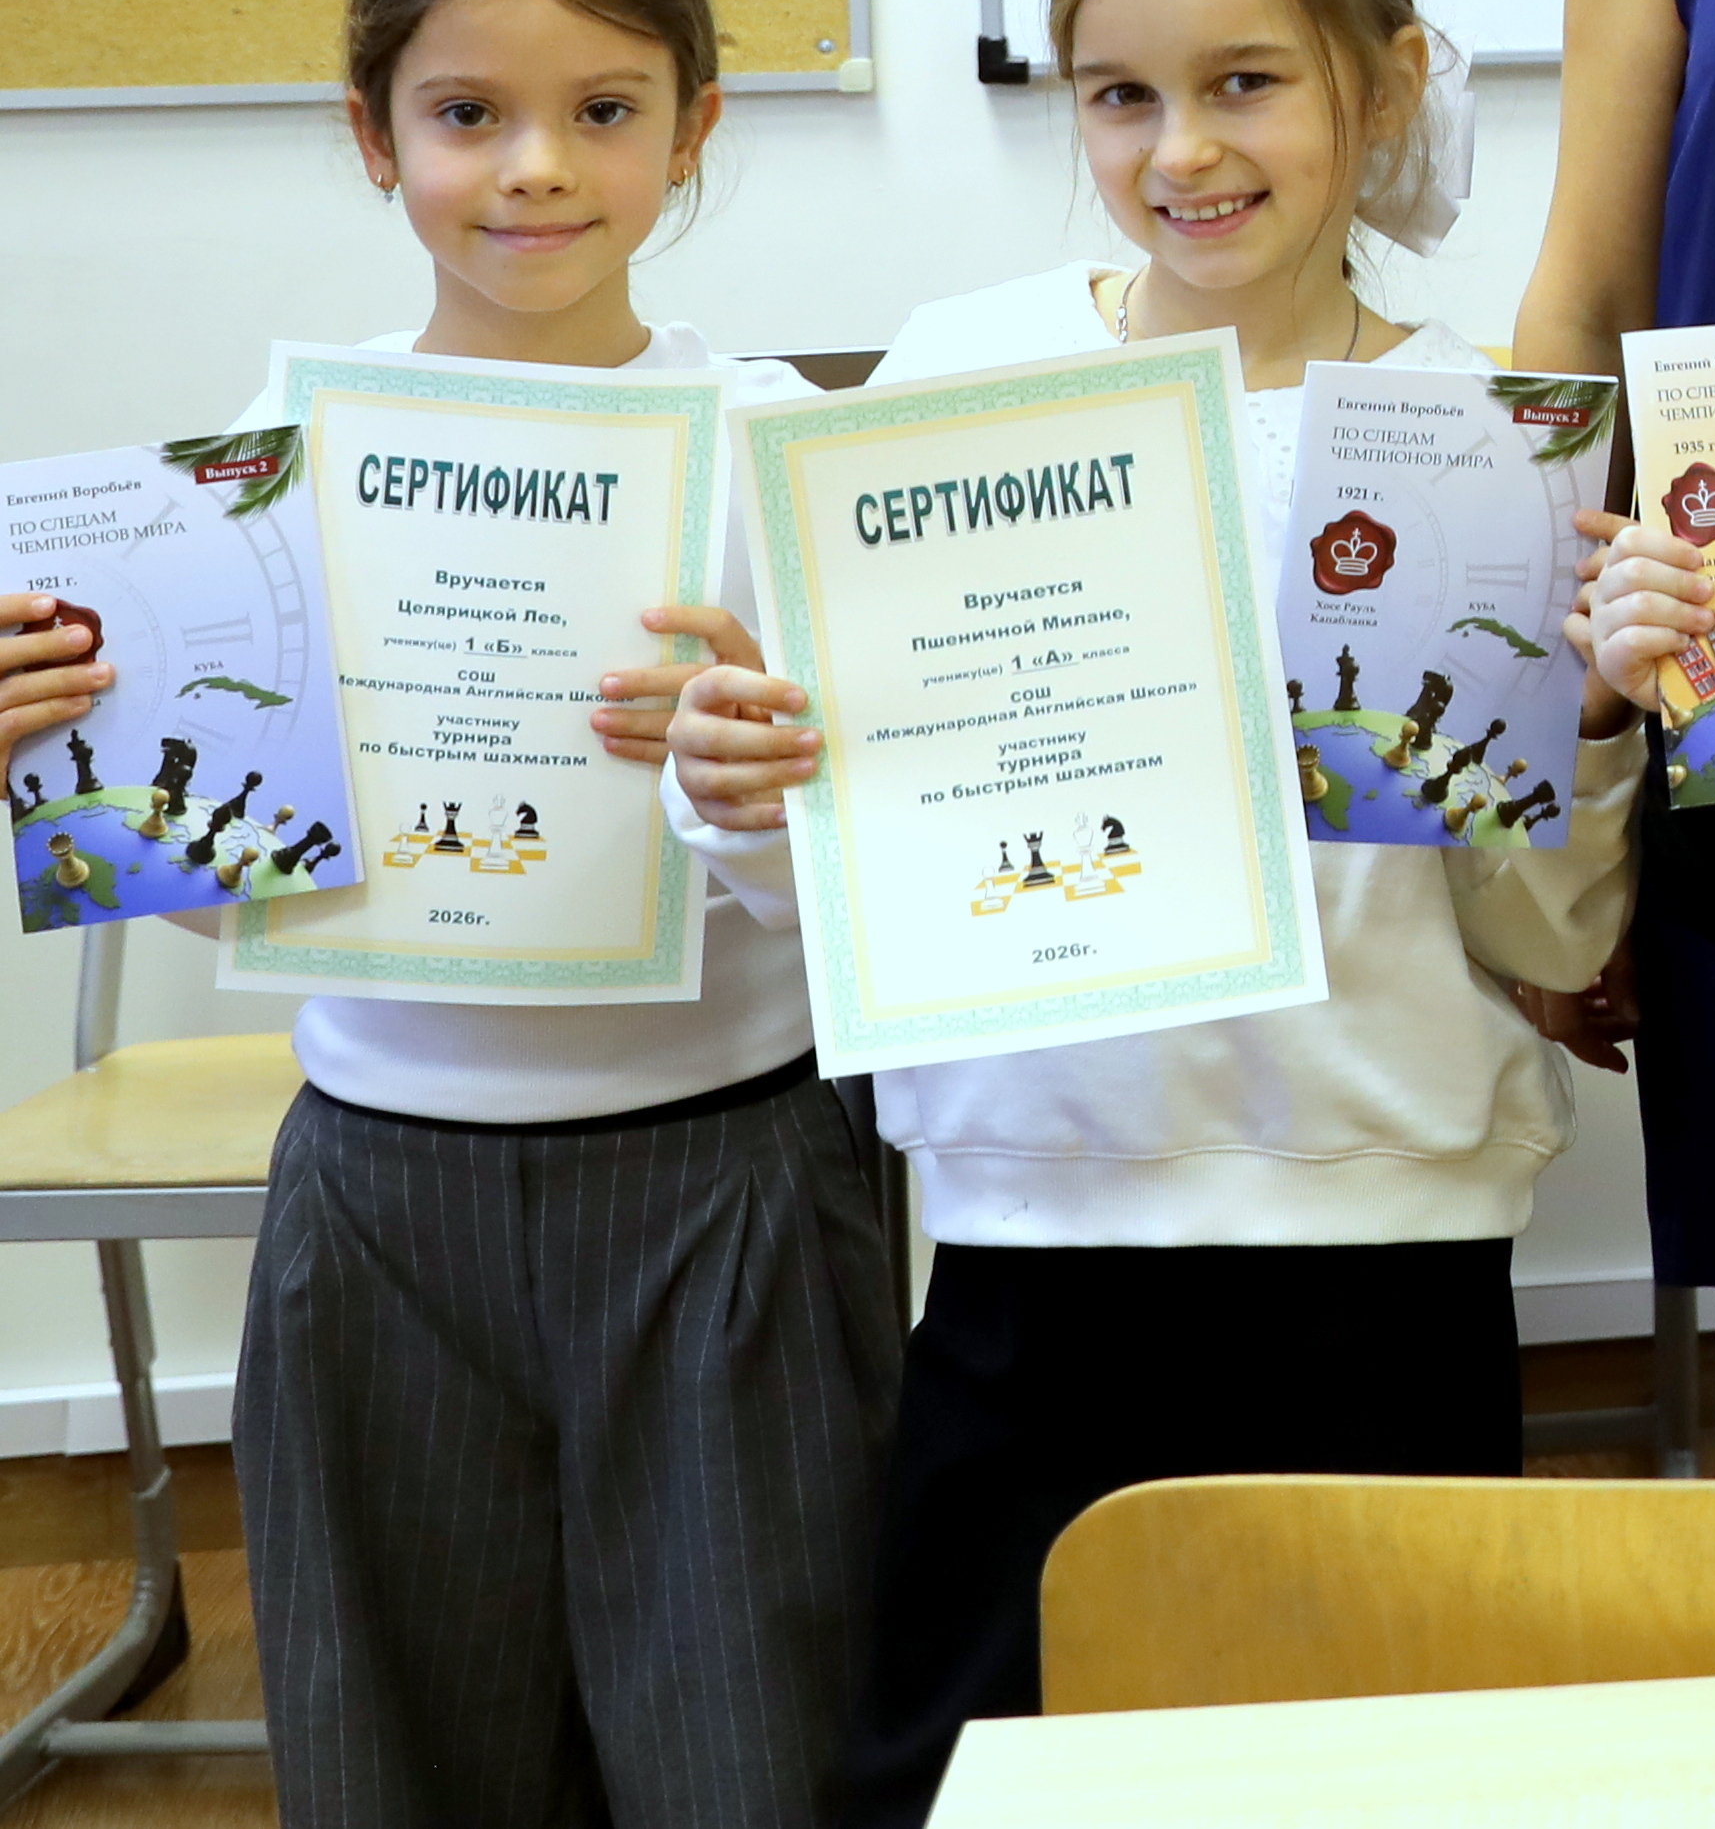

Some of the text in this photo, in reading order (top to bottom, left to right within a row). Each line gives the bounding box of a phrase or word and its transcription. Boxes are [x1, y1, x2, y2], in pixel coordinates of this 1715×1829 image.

[1658, 389, 1682, 402] ПО
[1338, 398, 1463, 417] Евгений Воробьёв
[1523, 409, 1569, 423] Выпуск
[1334, 427, 1434, 446] ПО СЛЕДАМ
[1675, 441, 1704, 454] 1935
[1332, 447, 1493, 468] ЧЕМПИОНОВ МИРА
[206, 465, 257, 482] Выпуск
[7, 481, 141, 506] Евгений Воробьёв
[359, 454, 618, 521] СЕРТИФИКАТ
[1339, 487, 1367, 499] 1921
[856, 454, 1133, 545] СЕРТИФИКАТ
[10, 511, 116, 536] ПО СЛЕДАМ
[12, 522, 186, 554] ЧЕМПИОНОВ МИРА
[28, 577, 59, 590] 1921
[436, 571, 545, 591] Вручается
[964, 581, 1082, 610] Вручается
[399, 600, 566, 626] Целярицкой Лее,
[912, 609, 1129, 651] Пшеничной Милане,
[458, 670, 495, 682] СОШ
[466, 686, 563, 701] Английская
[1011, 687, 1051, 703] СОШ
[867, 683, 1196, 742] «Международная Английская Школа»
[438, 716, 519, 731] участнику
[434, 731, 511, 747] турнира
[999, 731, 1086, 760] участнику
[388, 742, 587, 766] быстрым шахматам
[998, 743, 1085, 777] турнира
[952, 750, 1162, 798] быстрым шахматам
[429, 910, 489, 925] 2026г.
[1033, 944, 1096, 963] 2026г.
